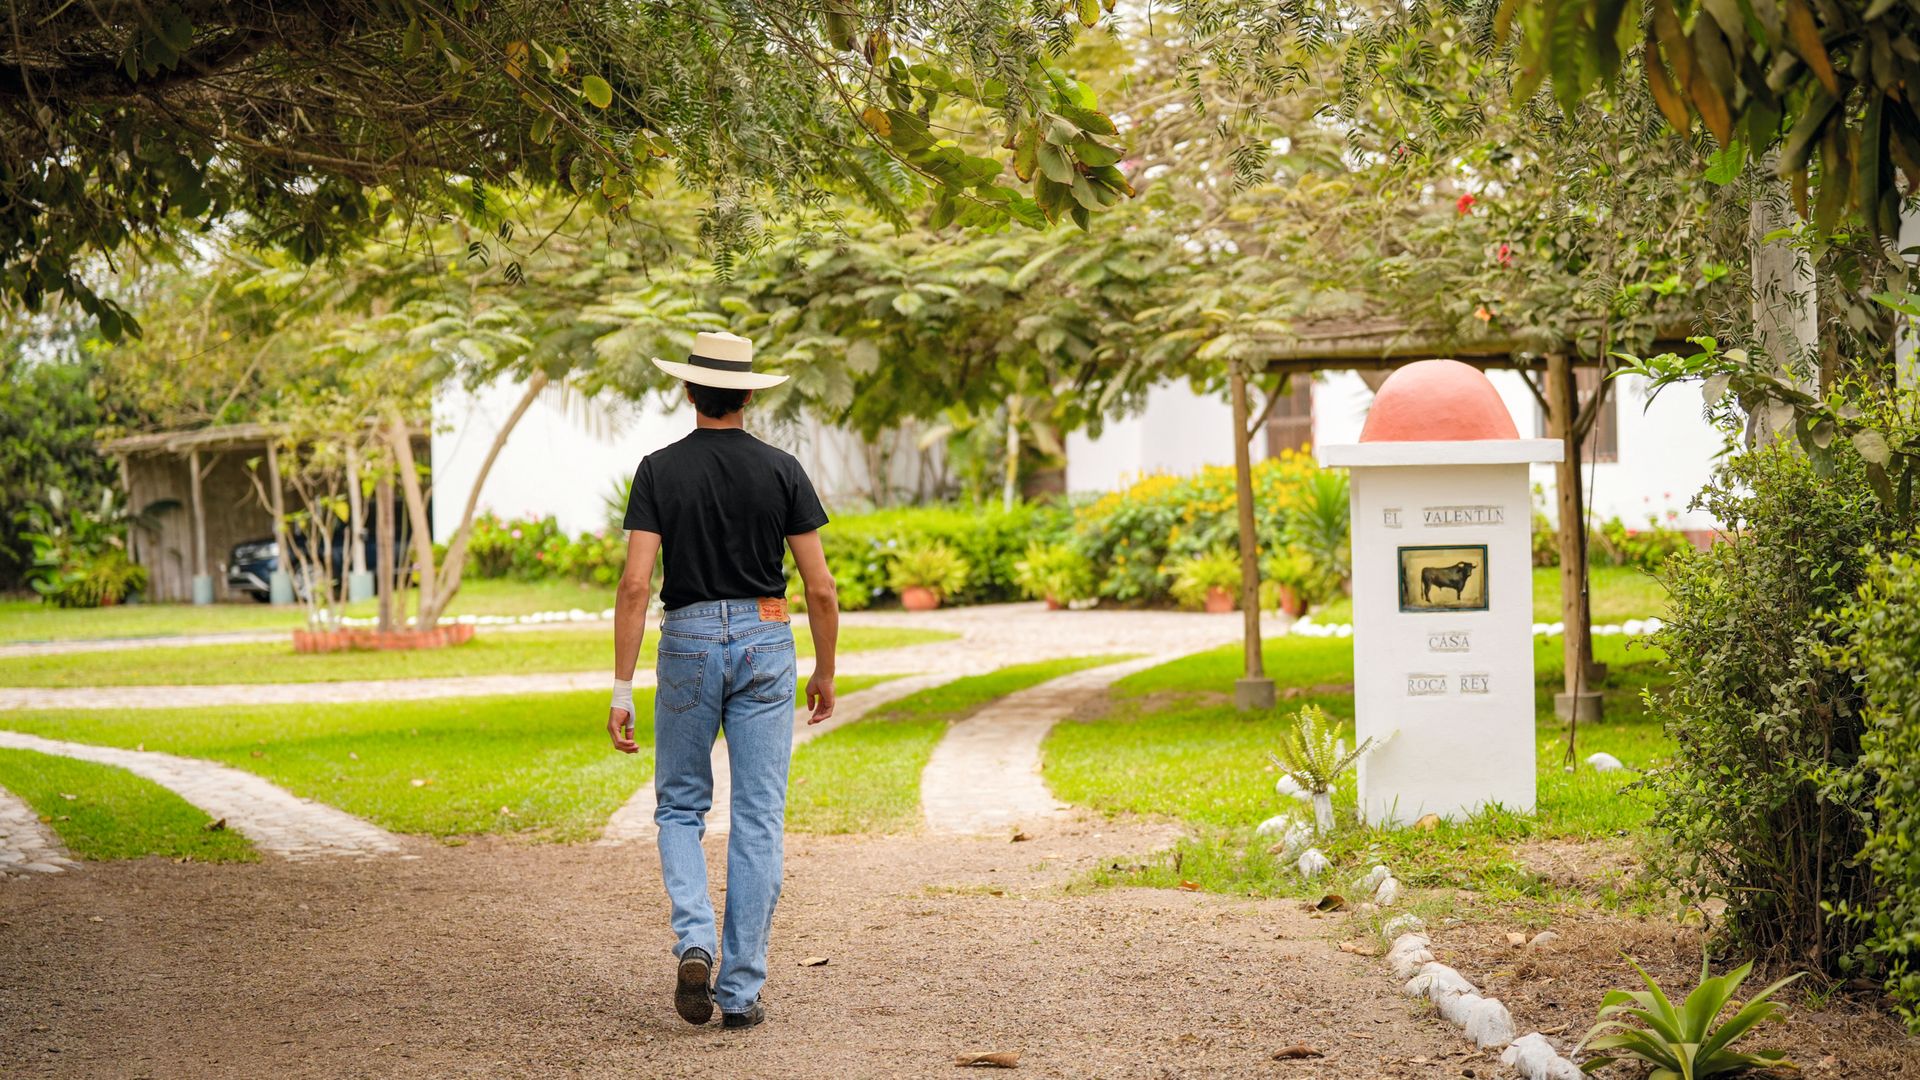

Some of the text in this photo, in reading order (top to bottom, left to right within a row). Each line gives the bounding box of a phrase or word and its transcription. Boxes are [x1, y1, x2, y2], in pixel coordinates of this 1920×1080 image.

[1383, 511, 1401, 525] EL
[1428, 635, 1470, 649] CASA
[1407, 677, 1489, 692] ROCA REY
